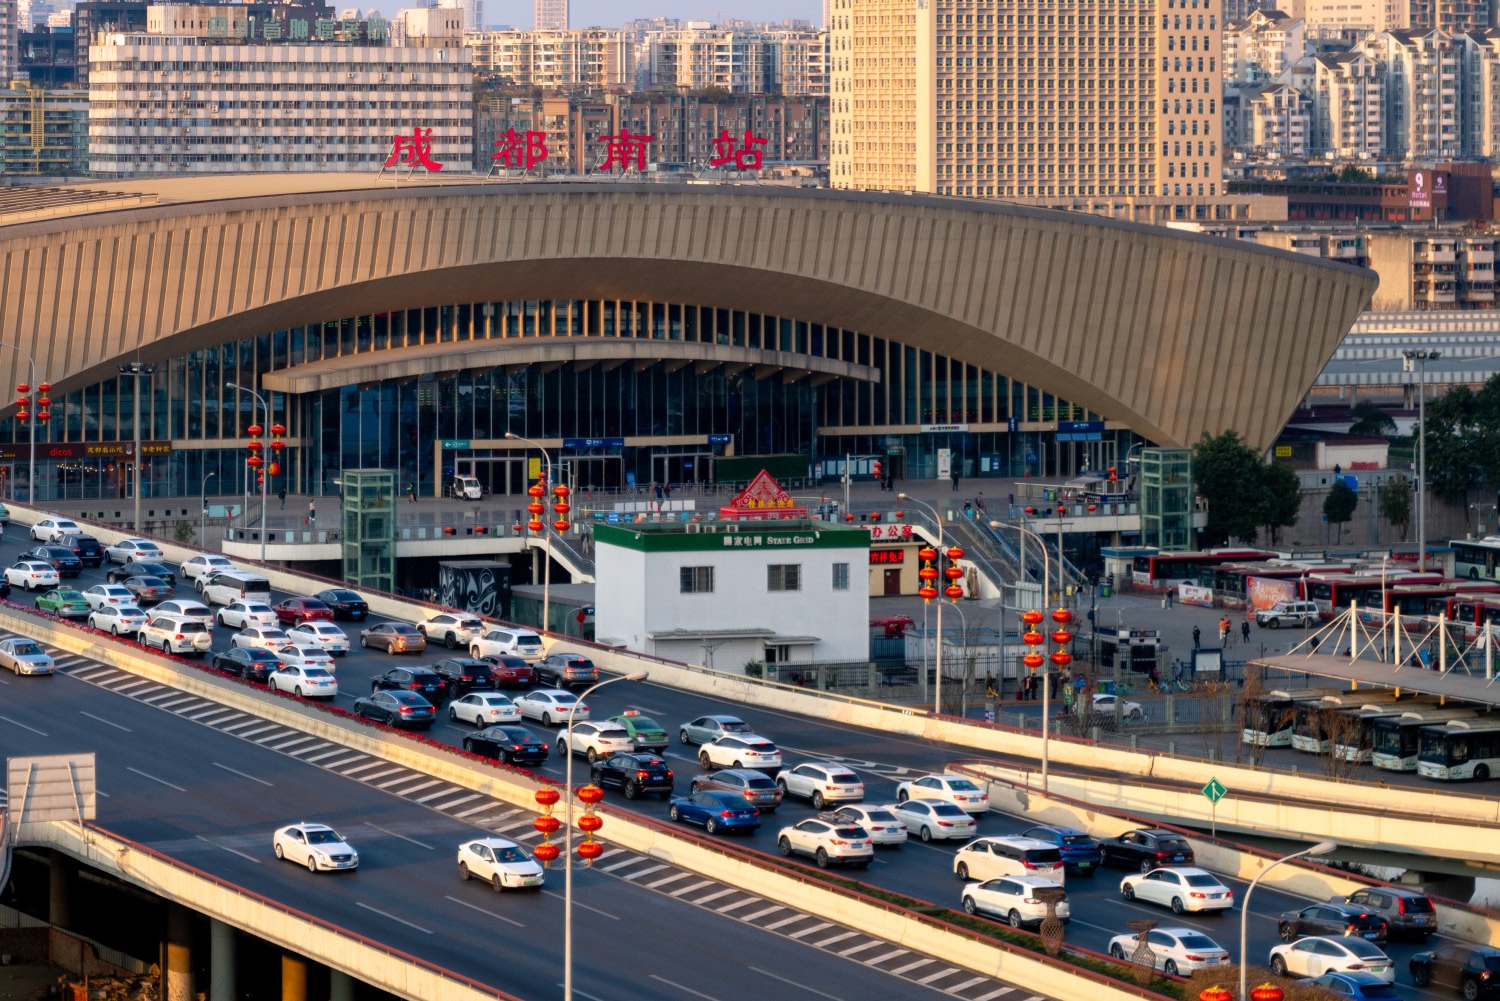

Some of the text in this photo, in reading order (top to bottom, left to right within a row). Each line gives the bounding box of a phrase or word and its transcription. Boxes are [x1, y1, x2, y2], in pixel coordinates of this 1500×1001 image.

[209, 16, 388, 40] 四川省肿瘤医院
[384, 127, 767, 172] 成都南站
[50, 447, 73, 457] dicos
[87, 446, 124, 454] 成都名小吃
[724, 536, 762, 546] 国家电网
